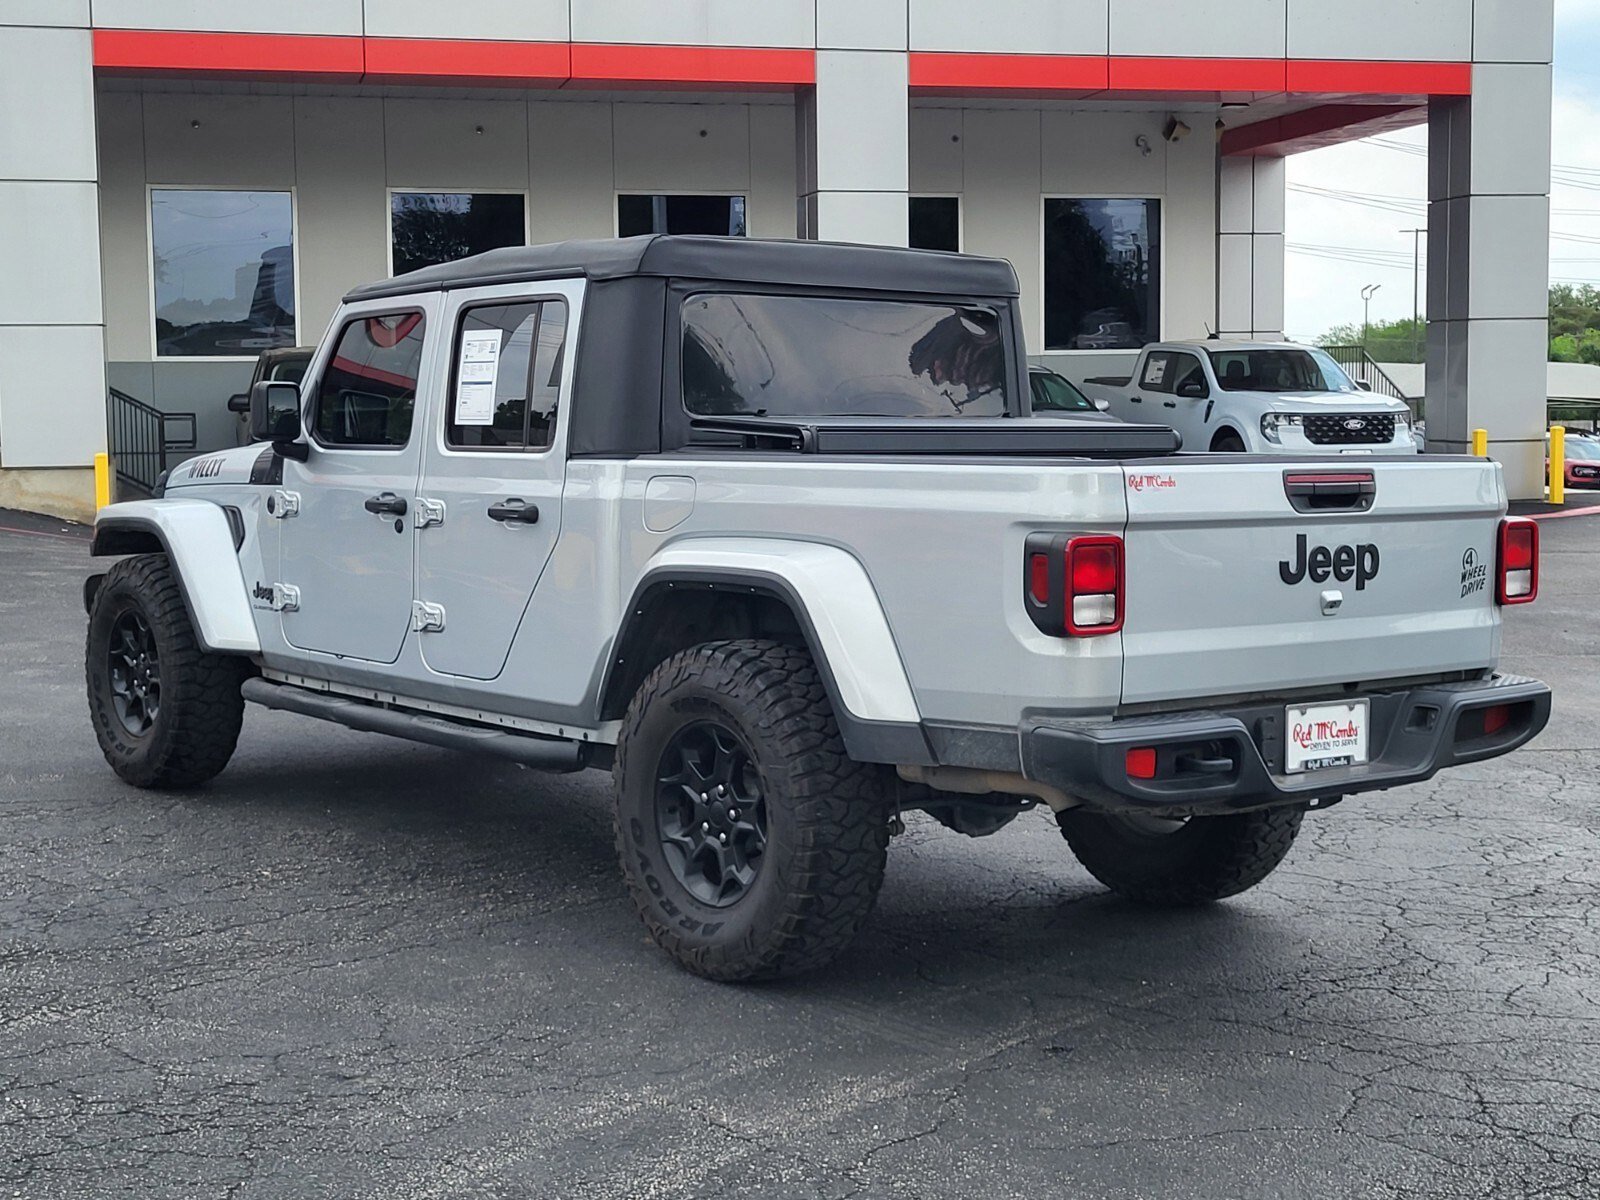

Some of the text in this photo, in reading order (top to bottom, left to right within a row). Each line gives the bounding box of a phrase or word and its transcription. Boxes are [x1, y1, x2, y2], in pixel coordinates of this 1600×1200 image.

[188, 458, 226, 479] WILLYS
[1128, 474, 1143, 492] Red
[1279, 533, 1380, 591] Jeep
[1461, 565, 1486, 584] WHEEL
[253, 580, 275, 605] Jeep
[1461, 578, 1485, 598] DRIVE
[1293, 723, 1313, 749] Red
[1309, 738, 1358, 750] DRIVEN TO SERVE
